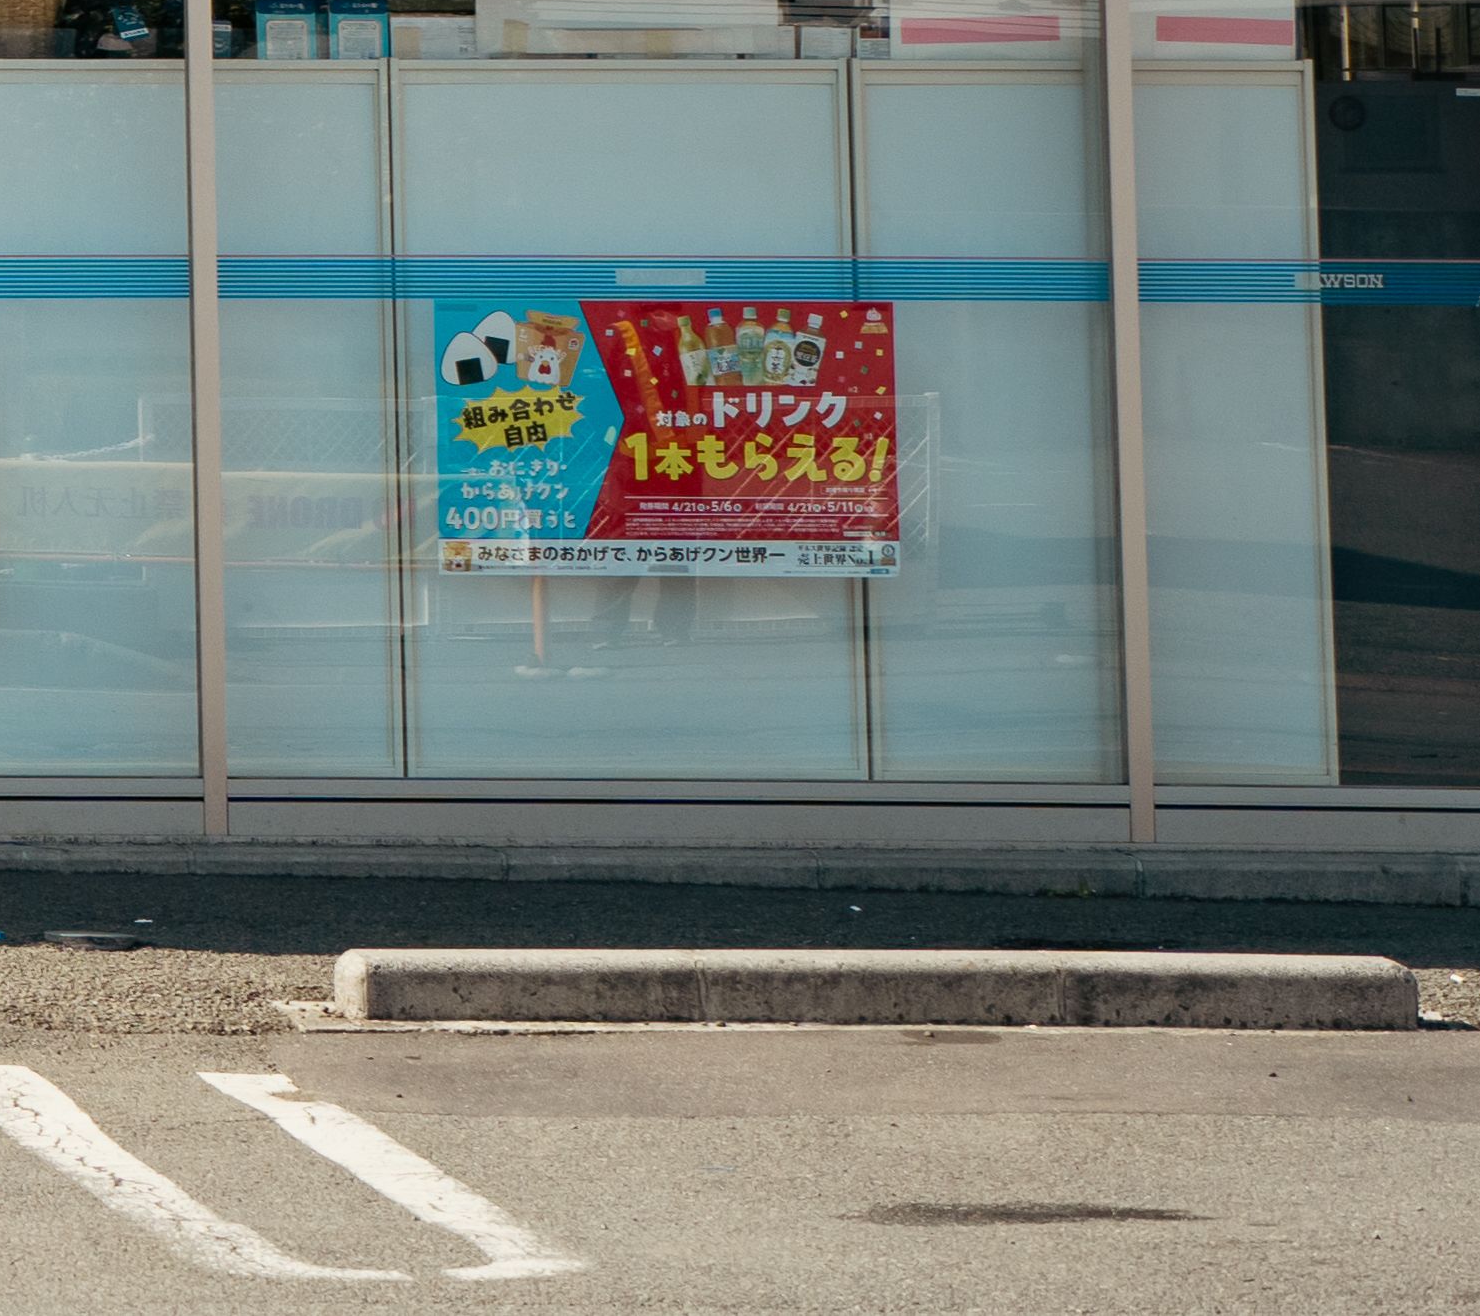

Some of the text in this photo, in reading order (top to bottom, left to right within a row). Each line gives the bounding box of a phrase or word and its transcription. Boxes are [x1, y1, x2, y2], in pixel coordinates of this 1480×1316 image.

[462, 391, 575, 431] 組み合わせ
[656, 410, 707, 427] 対象の
[713, 391, 849, 429] ドリンク
[504, 422, 548, 447] 自由
[623, 431, 890, 483] 1本もらえる!
[461, 481, 569, 500] からあげクン
[445, 505, 577, 531] 400円買うと
